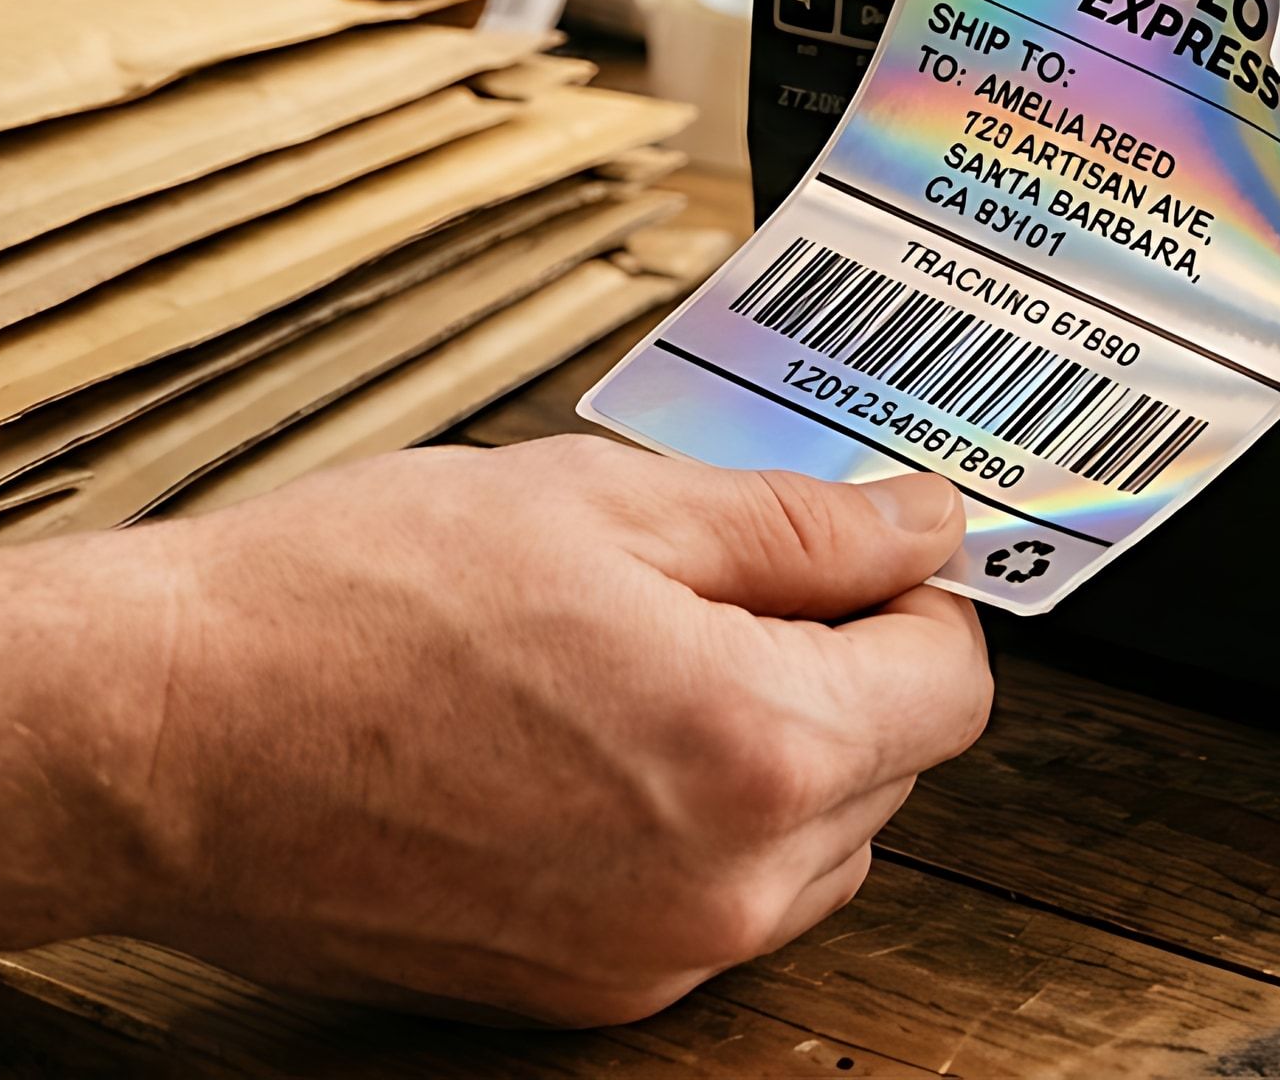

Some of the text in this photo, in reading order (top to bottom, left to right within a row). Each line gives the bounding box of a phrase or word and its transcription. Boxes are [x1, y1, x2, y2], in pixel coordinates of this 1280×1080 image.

[928, 2, 1011, 55] SHIP
[1020, 39, 1076, 88] TO:
[918, 45, 967, 87] TO:
[974, 73, 1085, 142] AMELIA
[924, 176, 968, 216] CA
[1011, 134, 1148, 209] ARTISAN
[1047, 189, 1201, 285] BARBARA,
